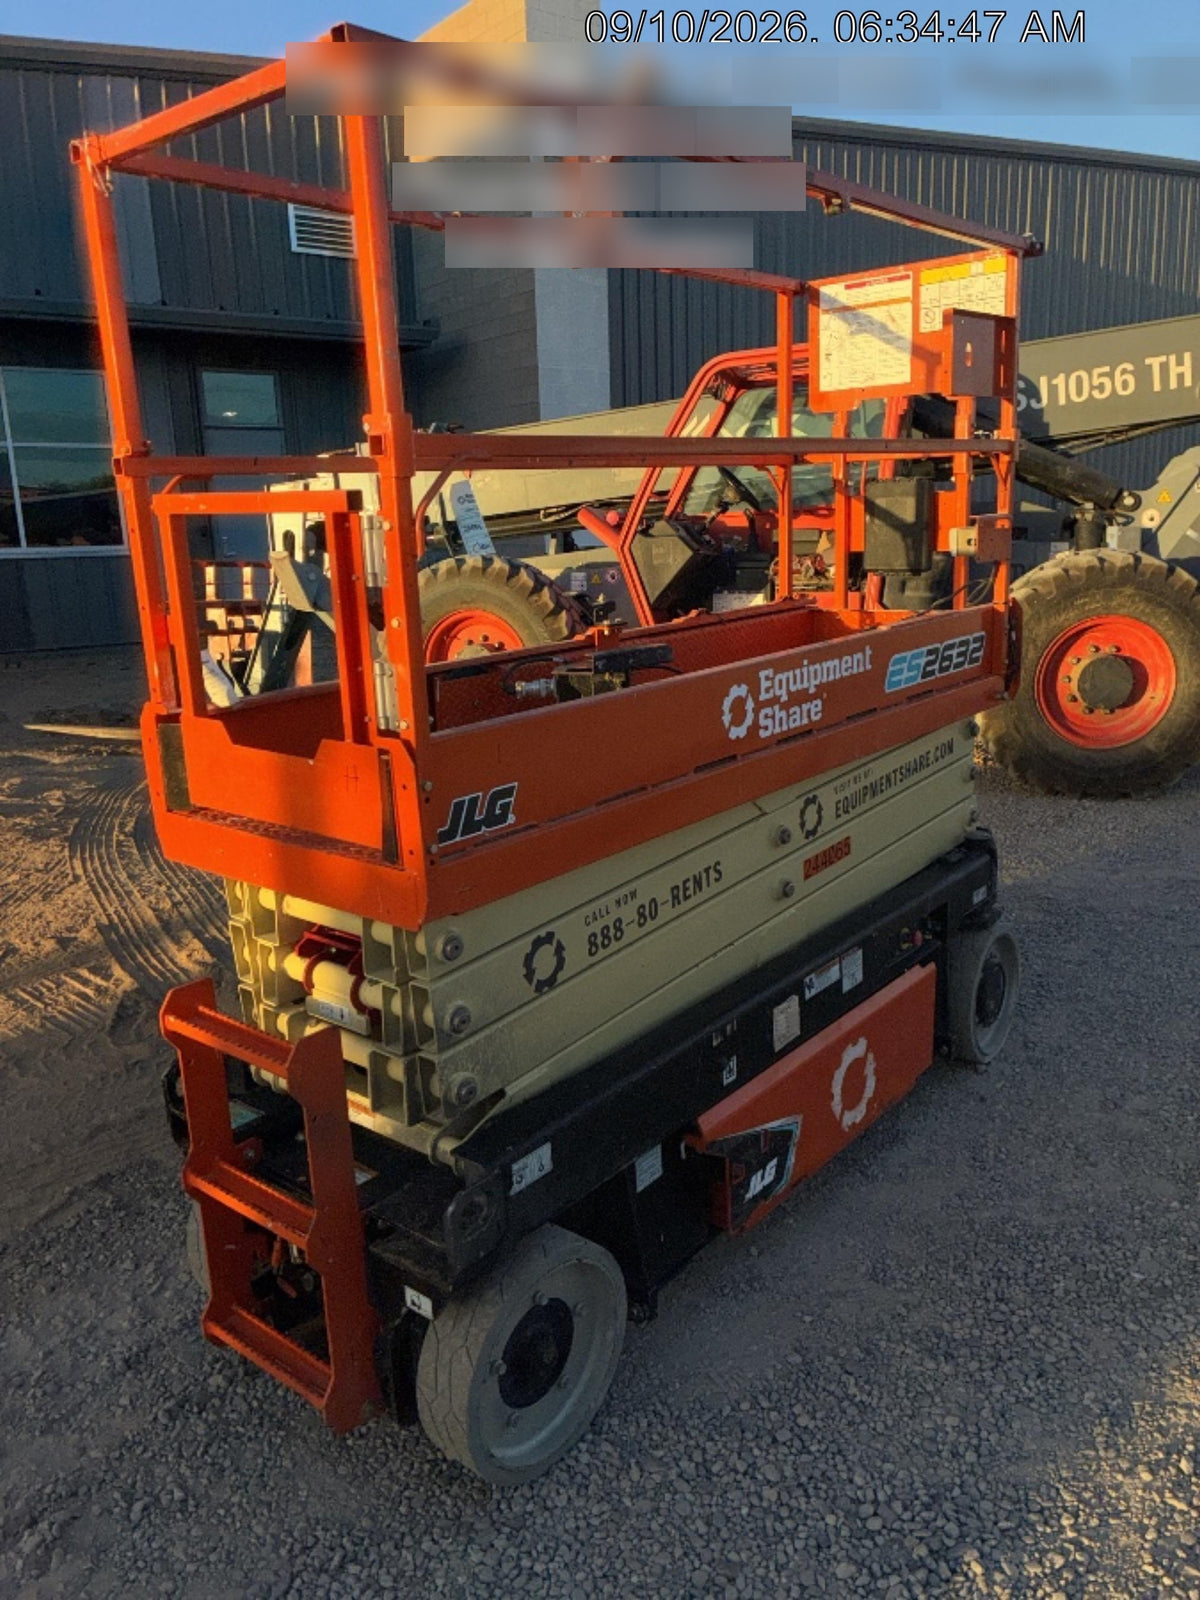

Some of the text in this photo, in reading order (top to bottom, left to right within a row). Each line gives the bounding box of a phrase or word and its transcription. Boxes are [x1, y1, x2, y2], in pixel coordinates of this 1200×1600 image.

[1145, 351, 1193, 392] TH
[759, 645, 873, 701] Equipment
[885, 631, 986, 692] ES2632
[759, 698, 823, 738] Share
[835, 737, 955, 819] EQUIPMENTSHARE.COM
[437, 782, 518, 847] JLG
[584, 888, 638, 927] CALL NOW
[587, 860, 724, 957] 888-80-RENTS
[743, 1157, 778, 1204] JLG
